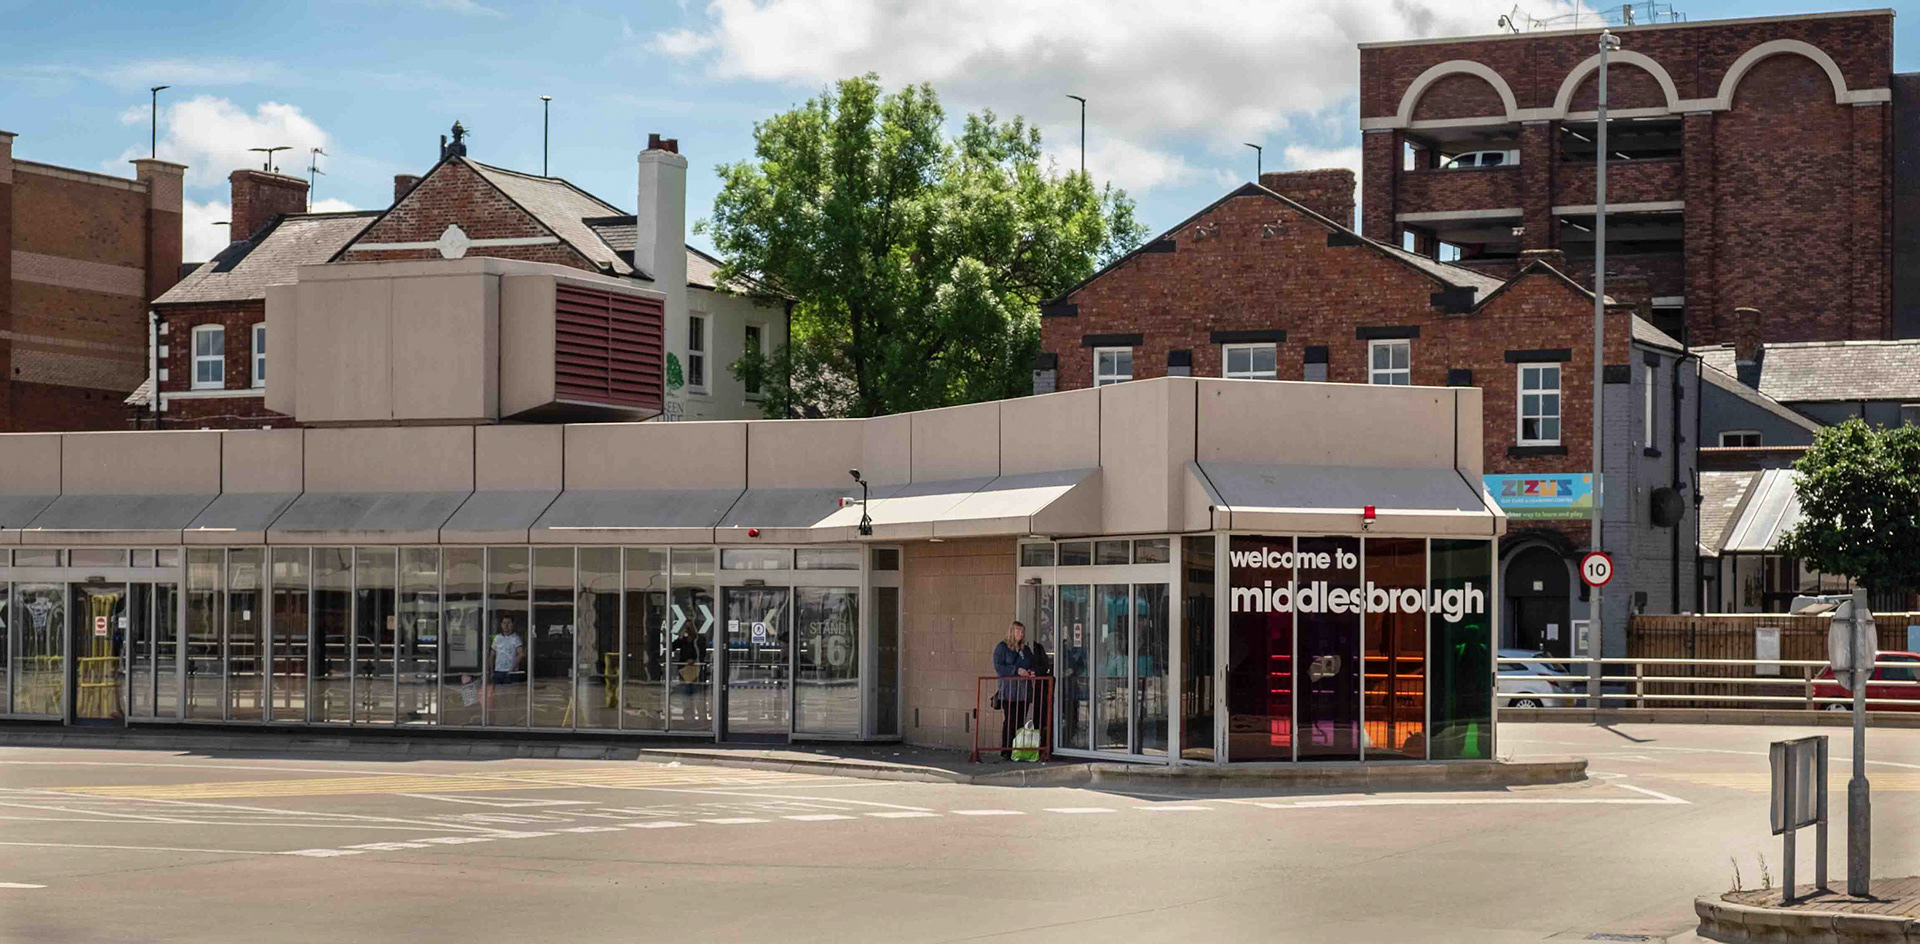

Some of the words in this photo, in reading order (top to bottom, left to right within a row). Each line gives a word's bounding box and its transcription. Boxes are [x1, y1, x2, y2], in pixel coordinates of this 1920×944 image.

[1502, 480, 1572, 496] ZIZUS
[1230, 546, 1331, 569] welcome
[1335, 547, 1358, 570] to
[1588, 563, 1606, 577] 10
[1230, 580, 1485, 623] middlesbrough
[809, 622, 846, 634] STAND
[809, 635, 846, 666] 16
